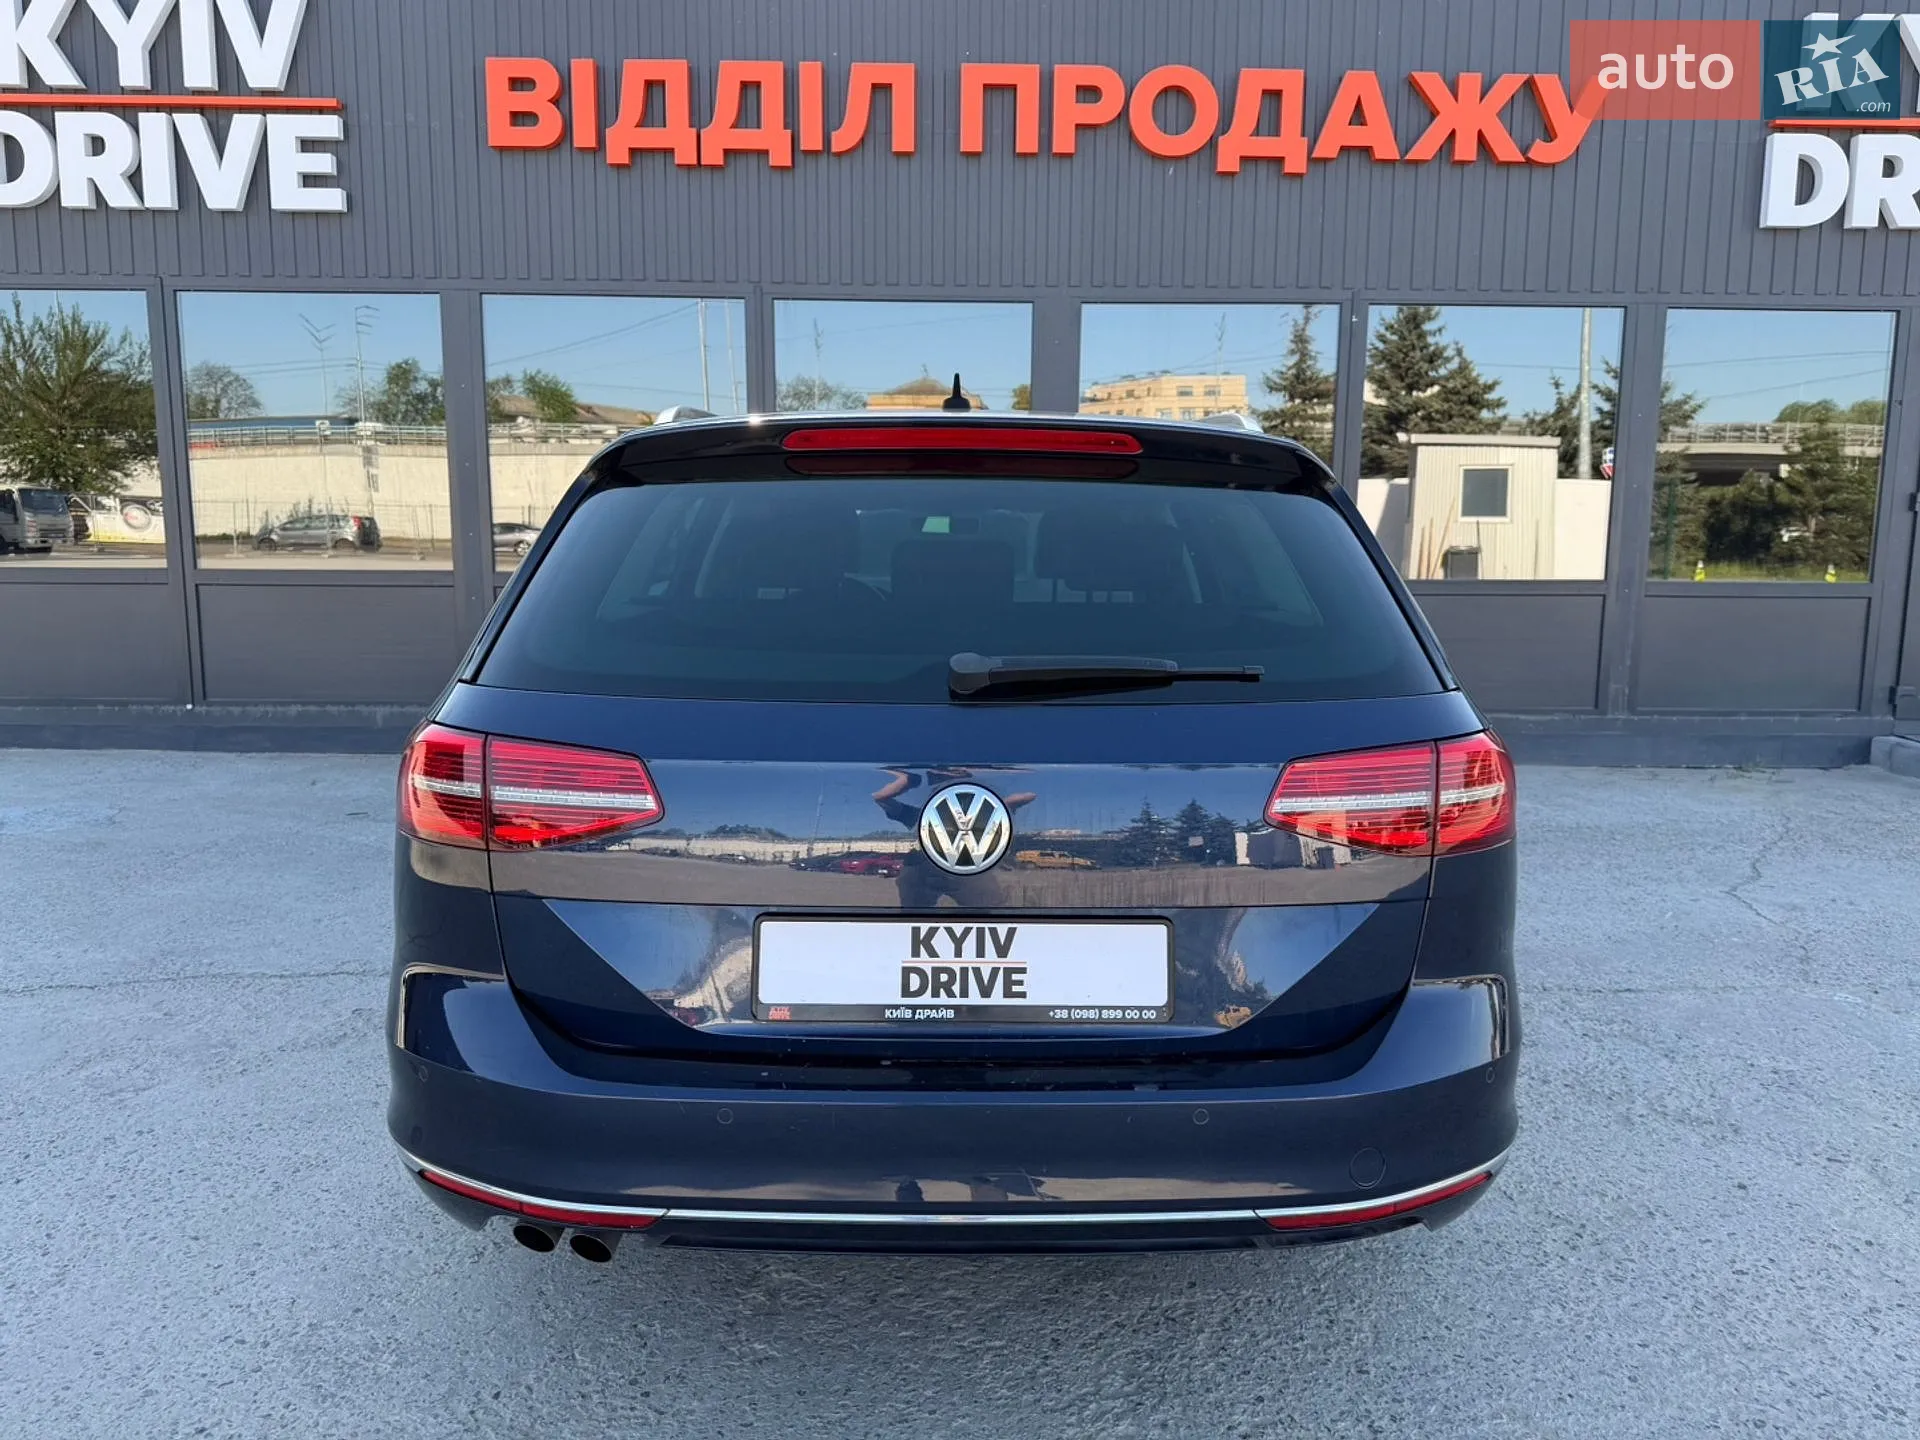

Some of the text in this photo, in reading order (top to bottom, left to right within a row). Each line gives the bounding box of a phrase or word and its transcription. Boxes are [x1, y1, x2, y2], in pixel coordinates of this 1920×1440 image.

[0, 0, 304, 92] KYIV
[485, 56, 1613, 175] ВІДДІЛ ПРОДАЖУ
[0, 110, 348, 213] DRIVE
[910, 926, 1018, 959] KYIV
[900, 966, 1028, 999] DRIVE
[884, 1007, 955, 1019] КИЇВ ДРАЙВ
[1048, 1008, 1157, 1020] +38 (098) 899 00 00
